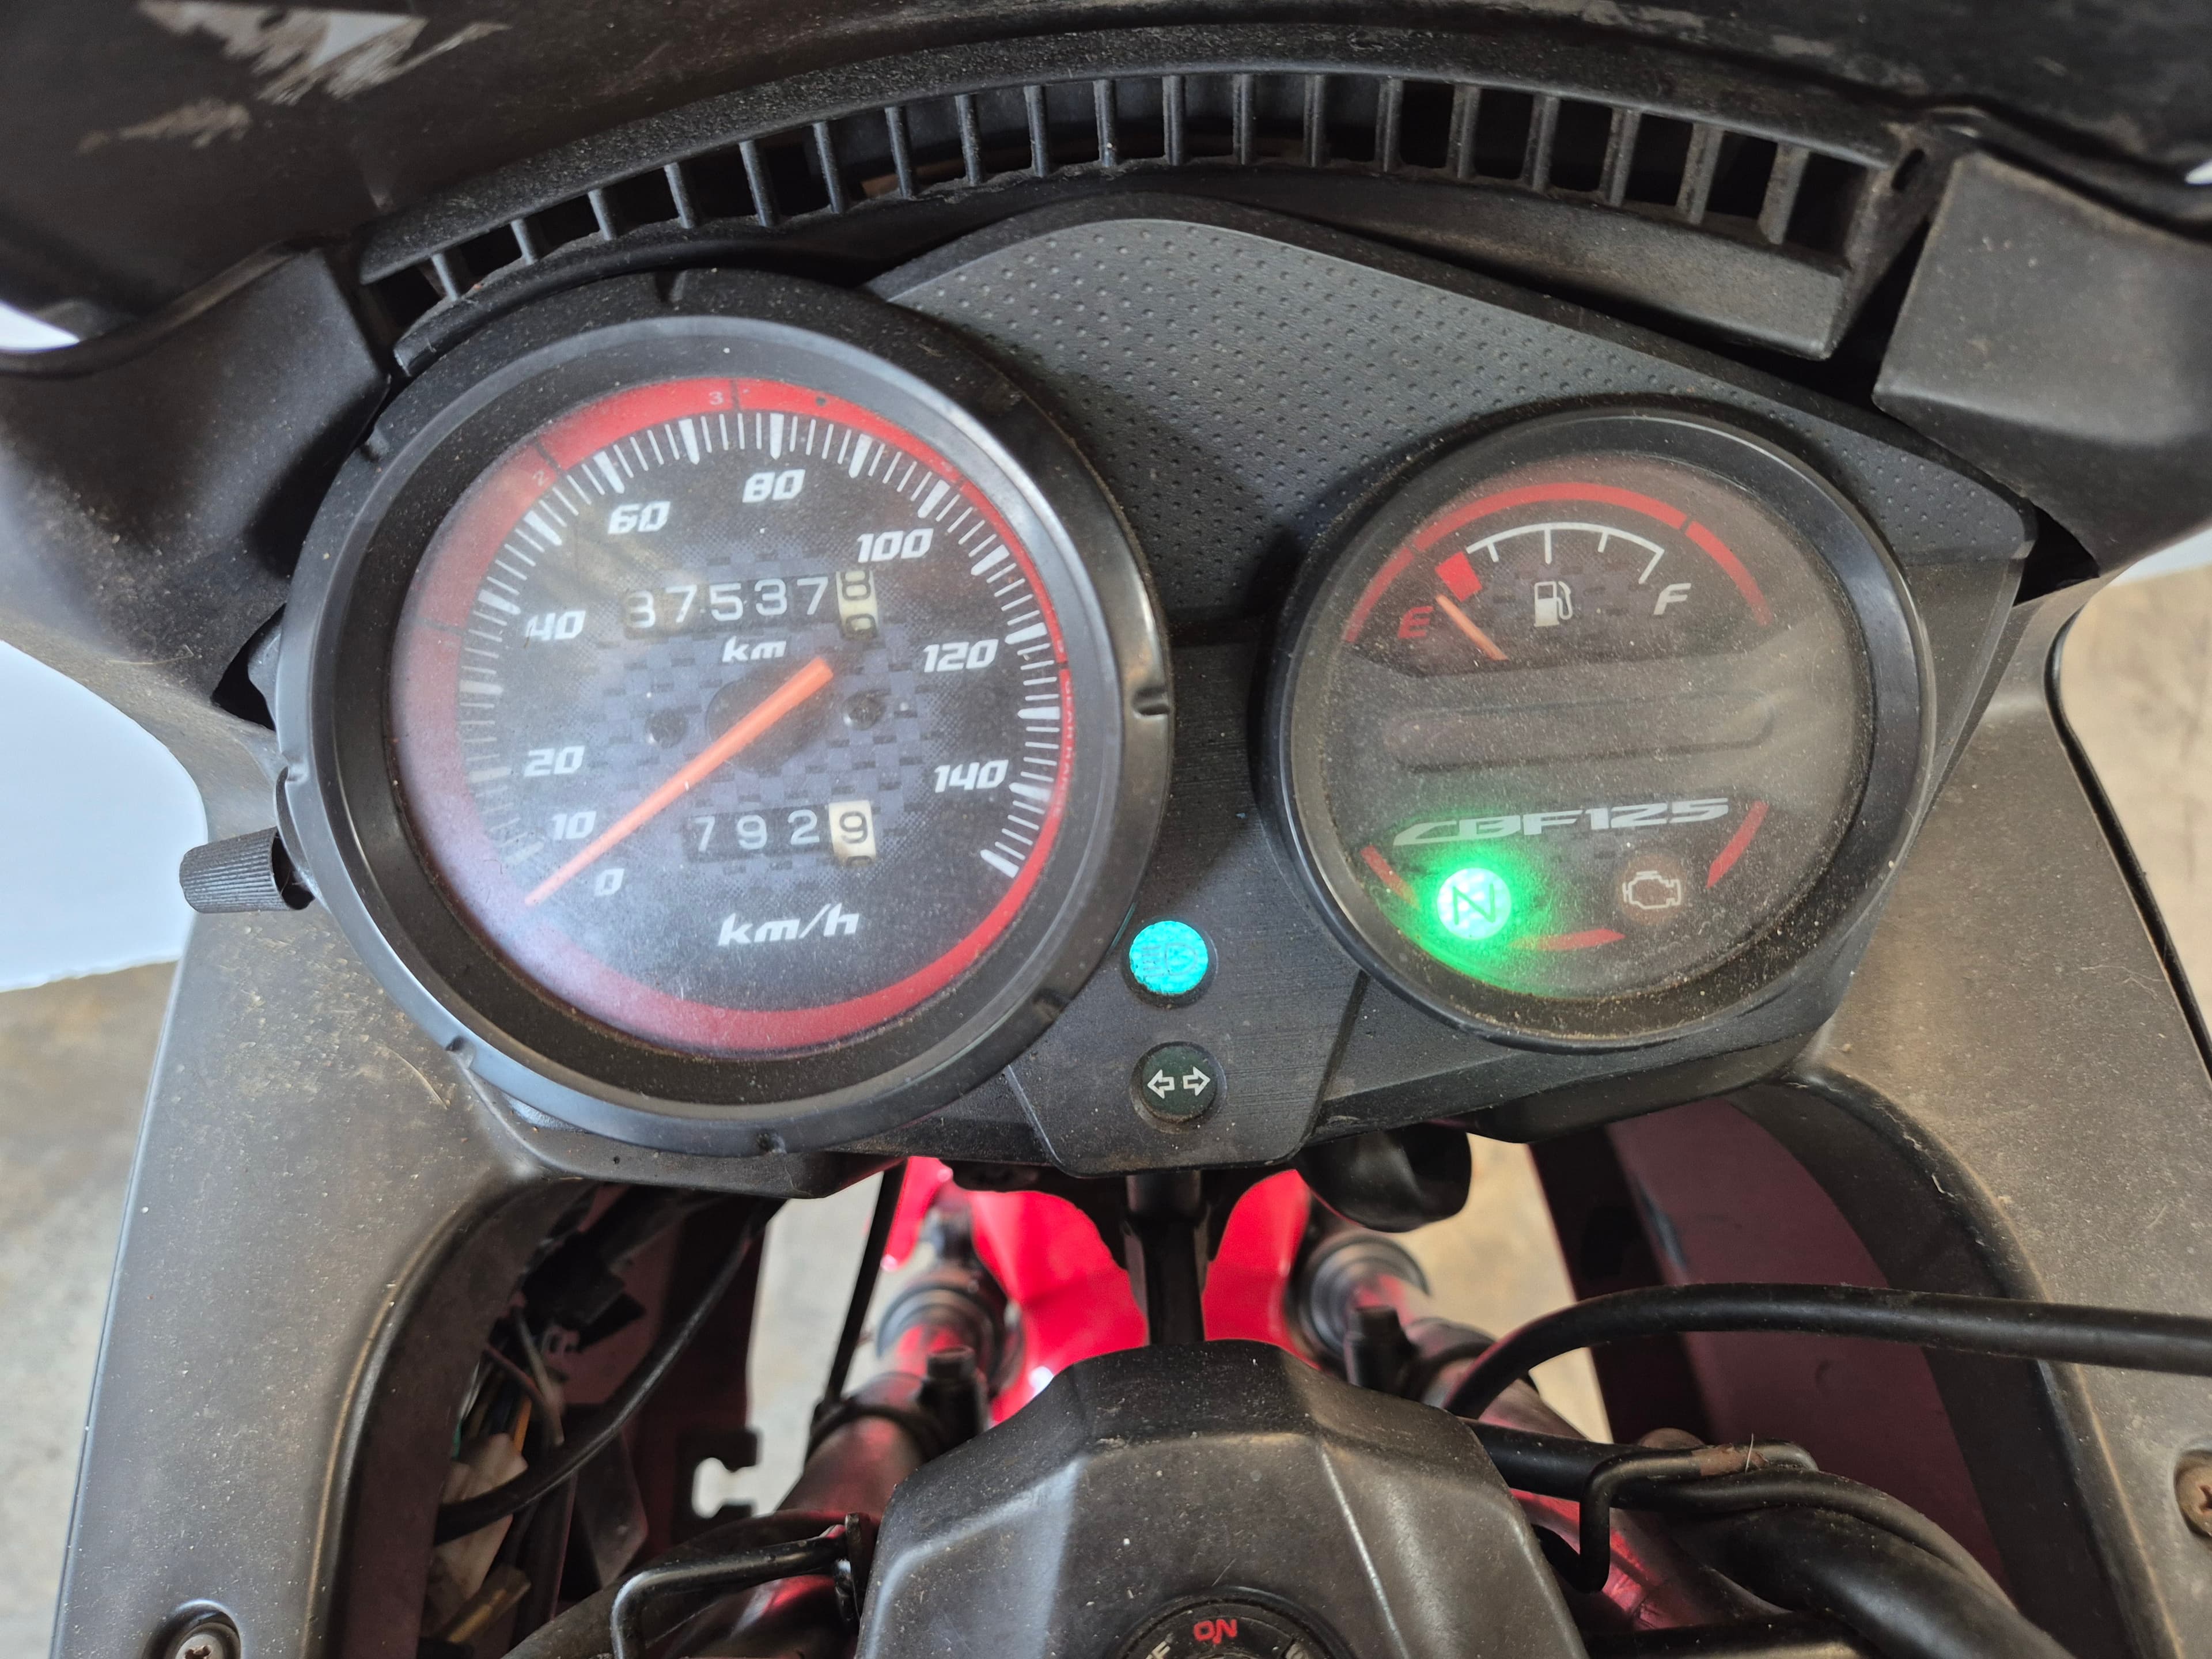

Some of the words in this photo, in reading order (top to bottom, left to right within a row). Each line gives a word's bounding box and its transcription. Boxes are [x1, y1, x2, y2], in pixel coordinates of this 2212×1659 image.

[743, 469, 805, 503] 80
[608, 501, 671, 535] 60
[857, 528, 934, 563] 100
[1653, 582, 1692, 616] F
[525, 610, 586, 641] 40
[1398, 605, 1434, 639] E
[722, 637, 787, 662] km
[923, 639, 999, 673] 120
[524, 745, 585, 777] 20
[934, 759, 1009, 794] 140
[551, 810, 596, 840] 10
[694, 808, 869, 853] 7929
[1393, 798, 1729, 846] CBF125
[594, 868, 624, 897] 0
[1451, 882, 1496, 926] N
[717, 902, 860, 946] km/h
[1193, 1619, 1237, 1645] ON
